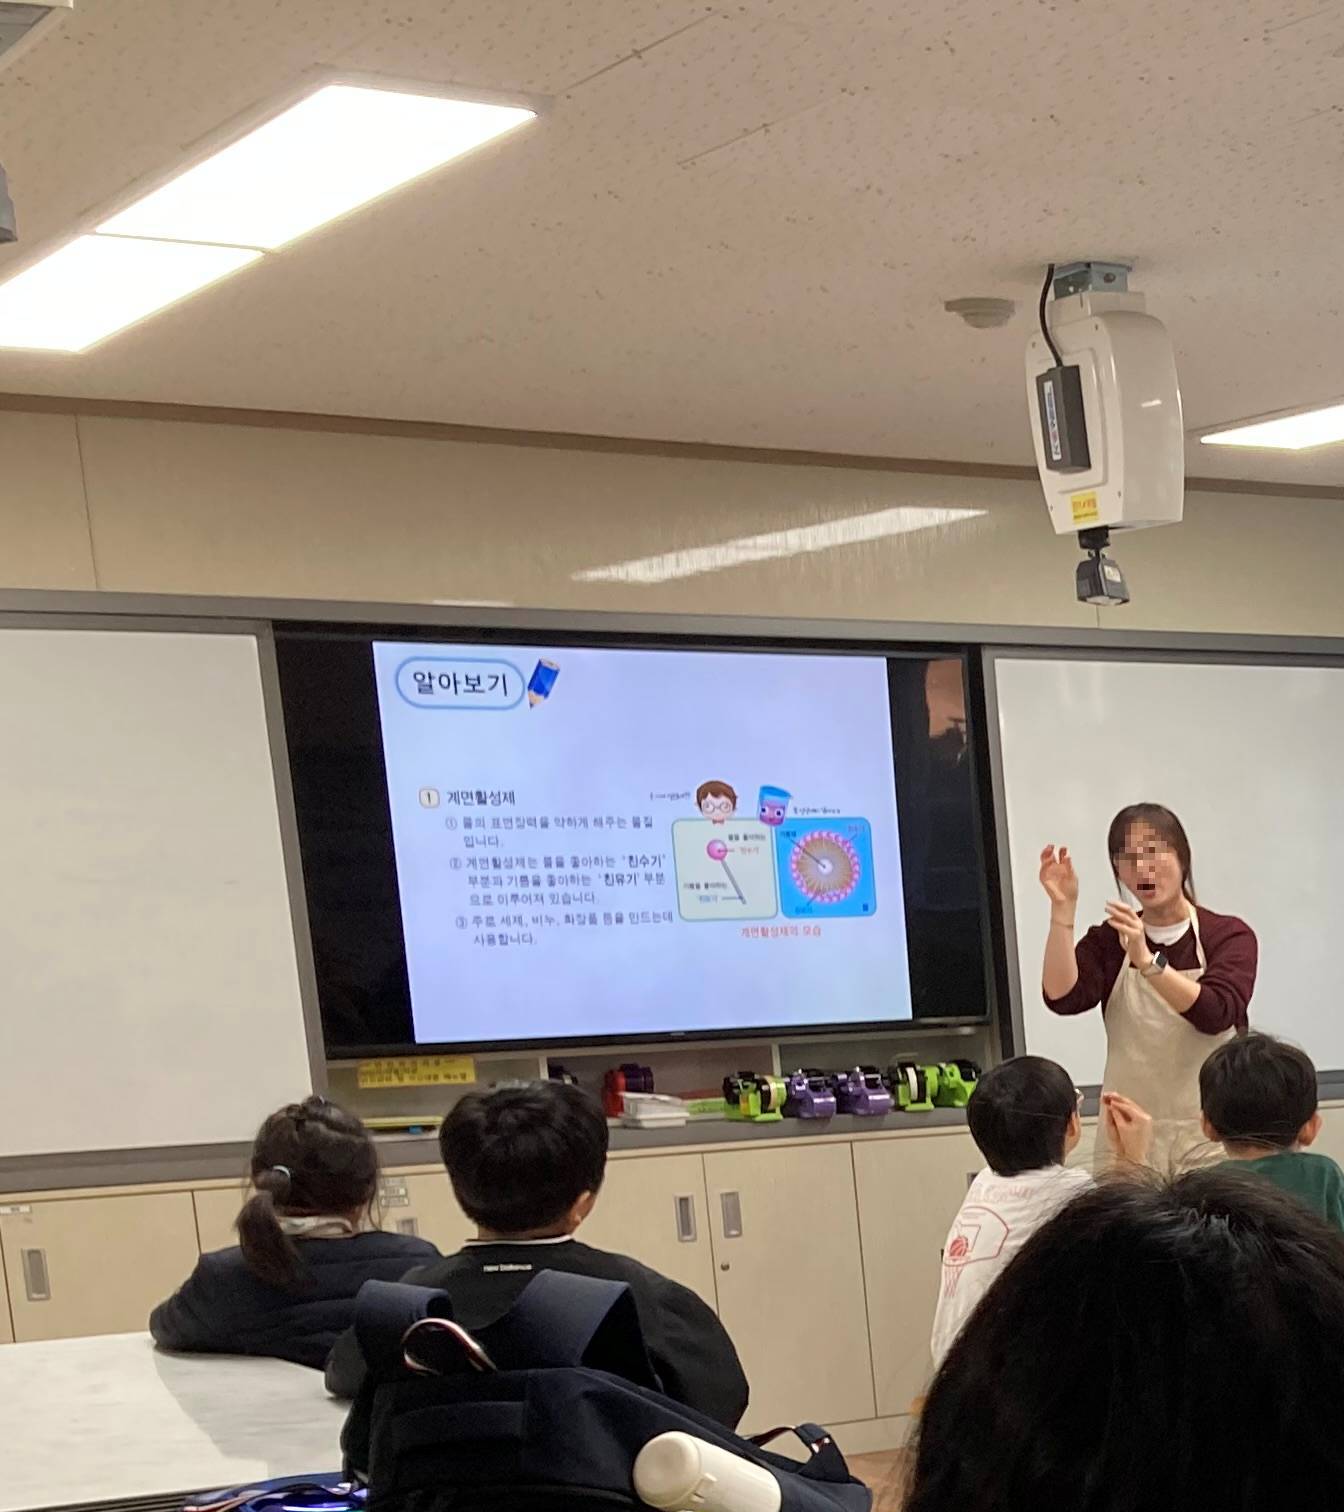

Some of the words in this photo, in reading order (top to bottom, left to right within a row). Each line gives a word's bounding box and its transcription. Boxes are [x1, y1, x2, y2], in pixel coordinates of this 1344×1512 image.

[412, 671, 509, 697] 알아보기
[446, 790, 517, 807] 계면활성제
[553, 816, 590, 829] 약하게
[463, 834, 504, 849] 입니다.
[466, 856, 538, 871] 계면활성제는
[467, 875, 504, 889] 부분과
[643, 872, 666, 886] 부분
[469, 893, 495, 907] 으로
[471, 915, 497, 929] 주로
[741, 926, 800, 939] 계면활성제의
[802, 924, 822, 937] 모습
[473, 932, 538, 948] 사용합니다.
